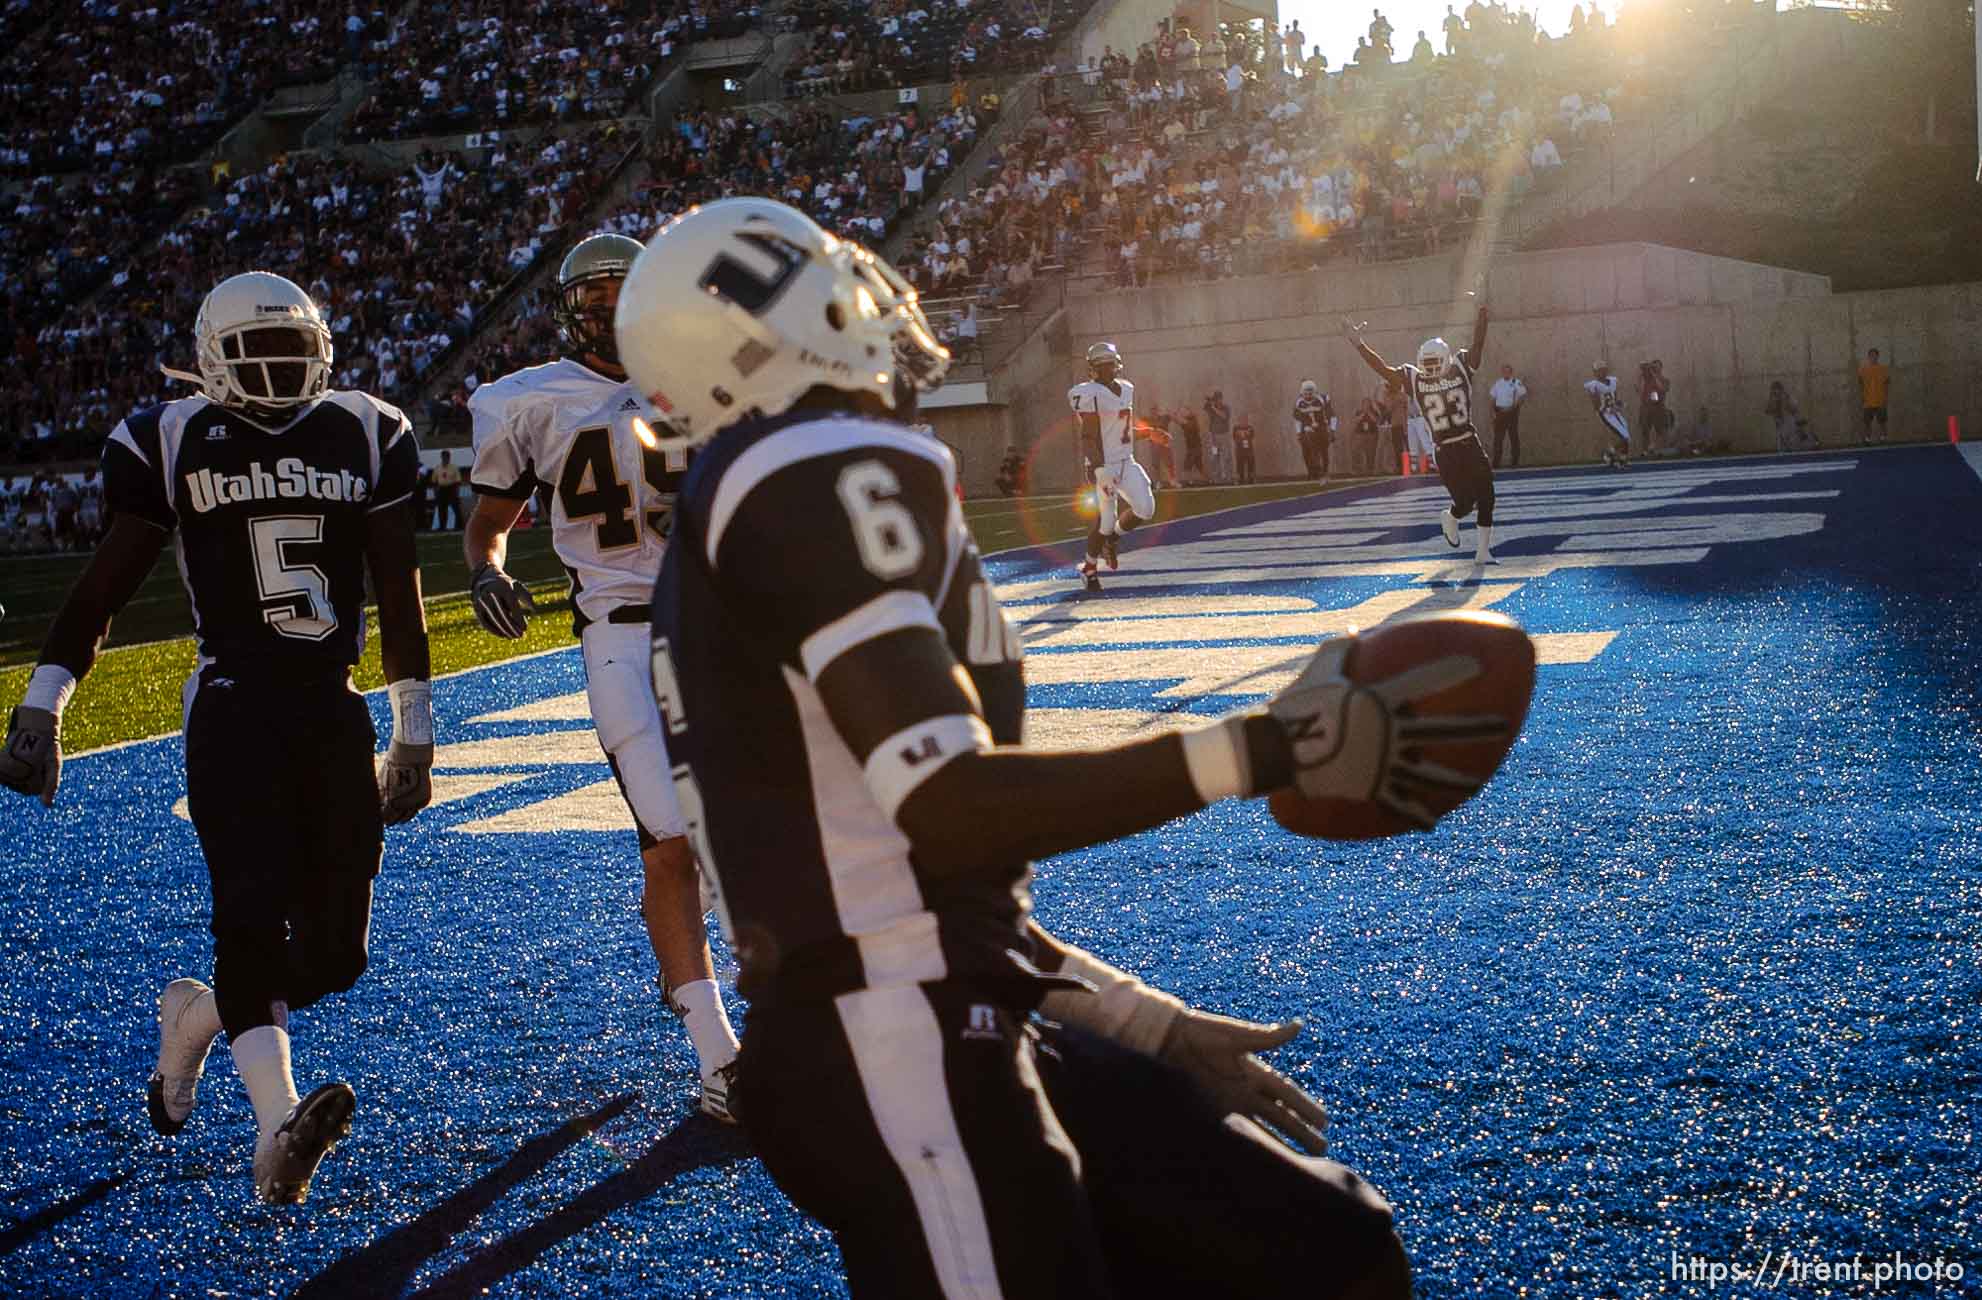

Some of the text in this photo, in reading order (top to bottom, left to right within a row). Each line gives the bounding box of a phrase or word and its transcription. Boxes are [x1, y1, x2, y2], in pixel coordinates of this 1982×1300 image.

[711, 386, 734, 408] 6
[1072, 395, 1081, 410] 7
[1424, 390, 1468, 432] 23
[835, 459, 923, 580] 6
[248, 514, 338, 641] 5
